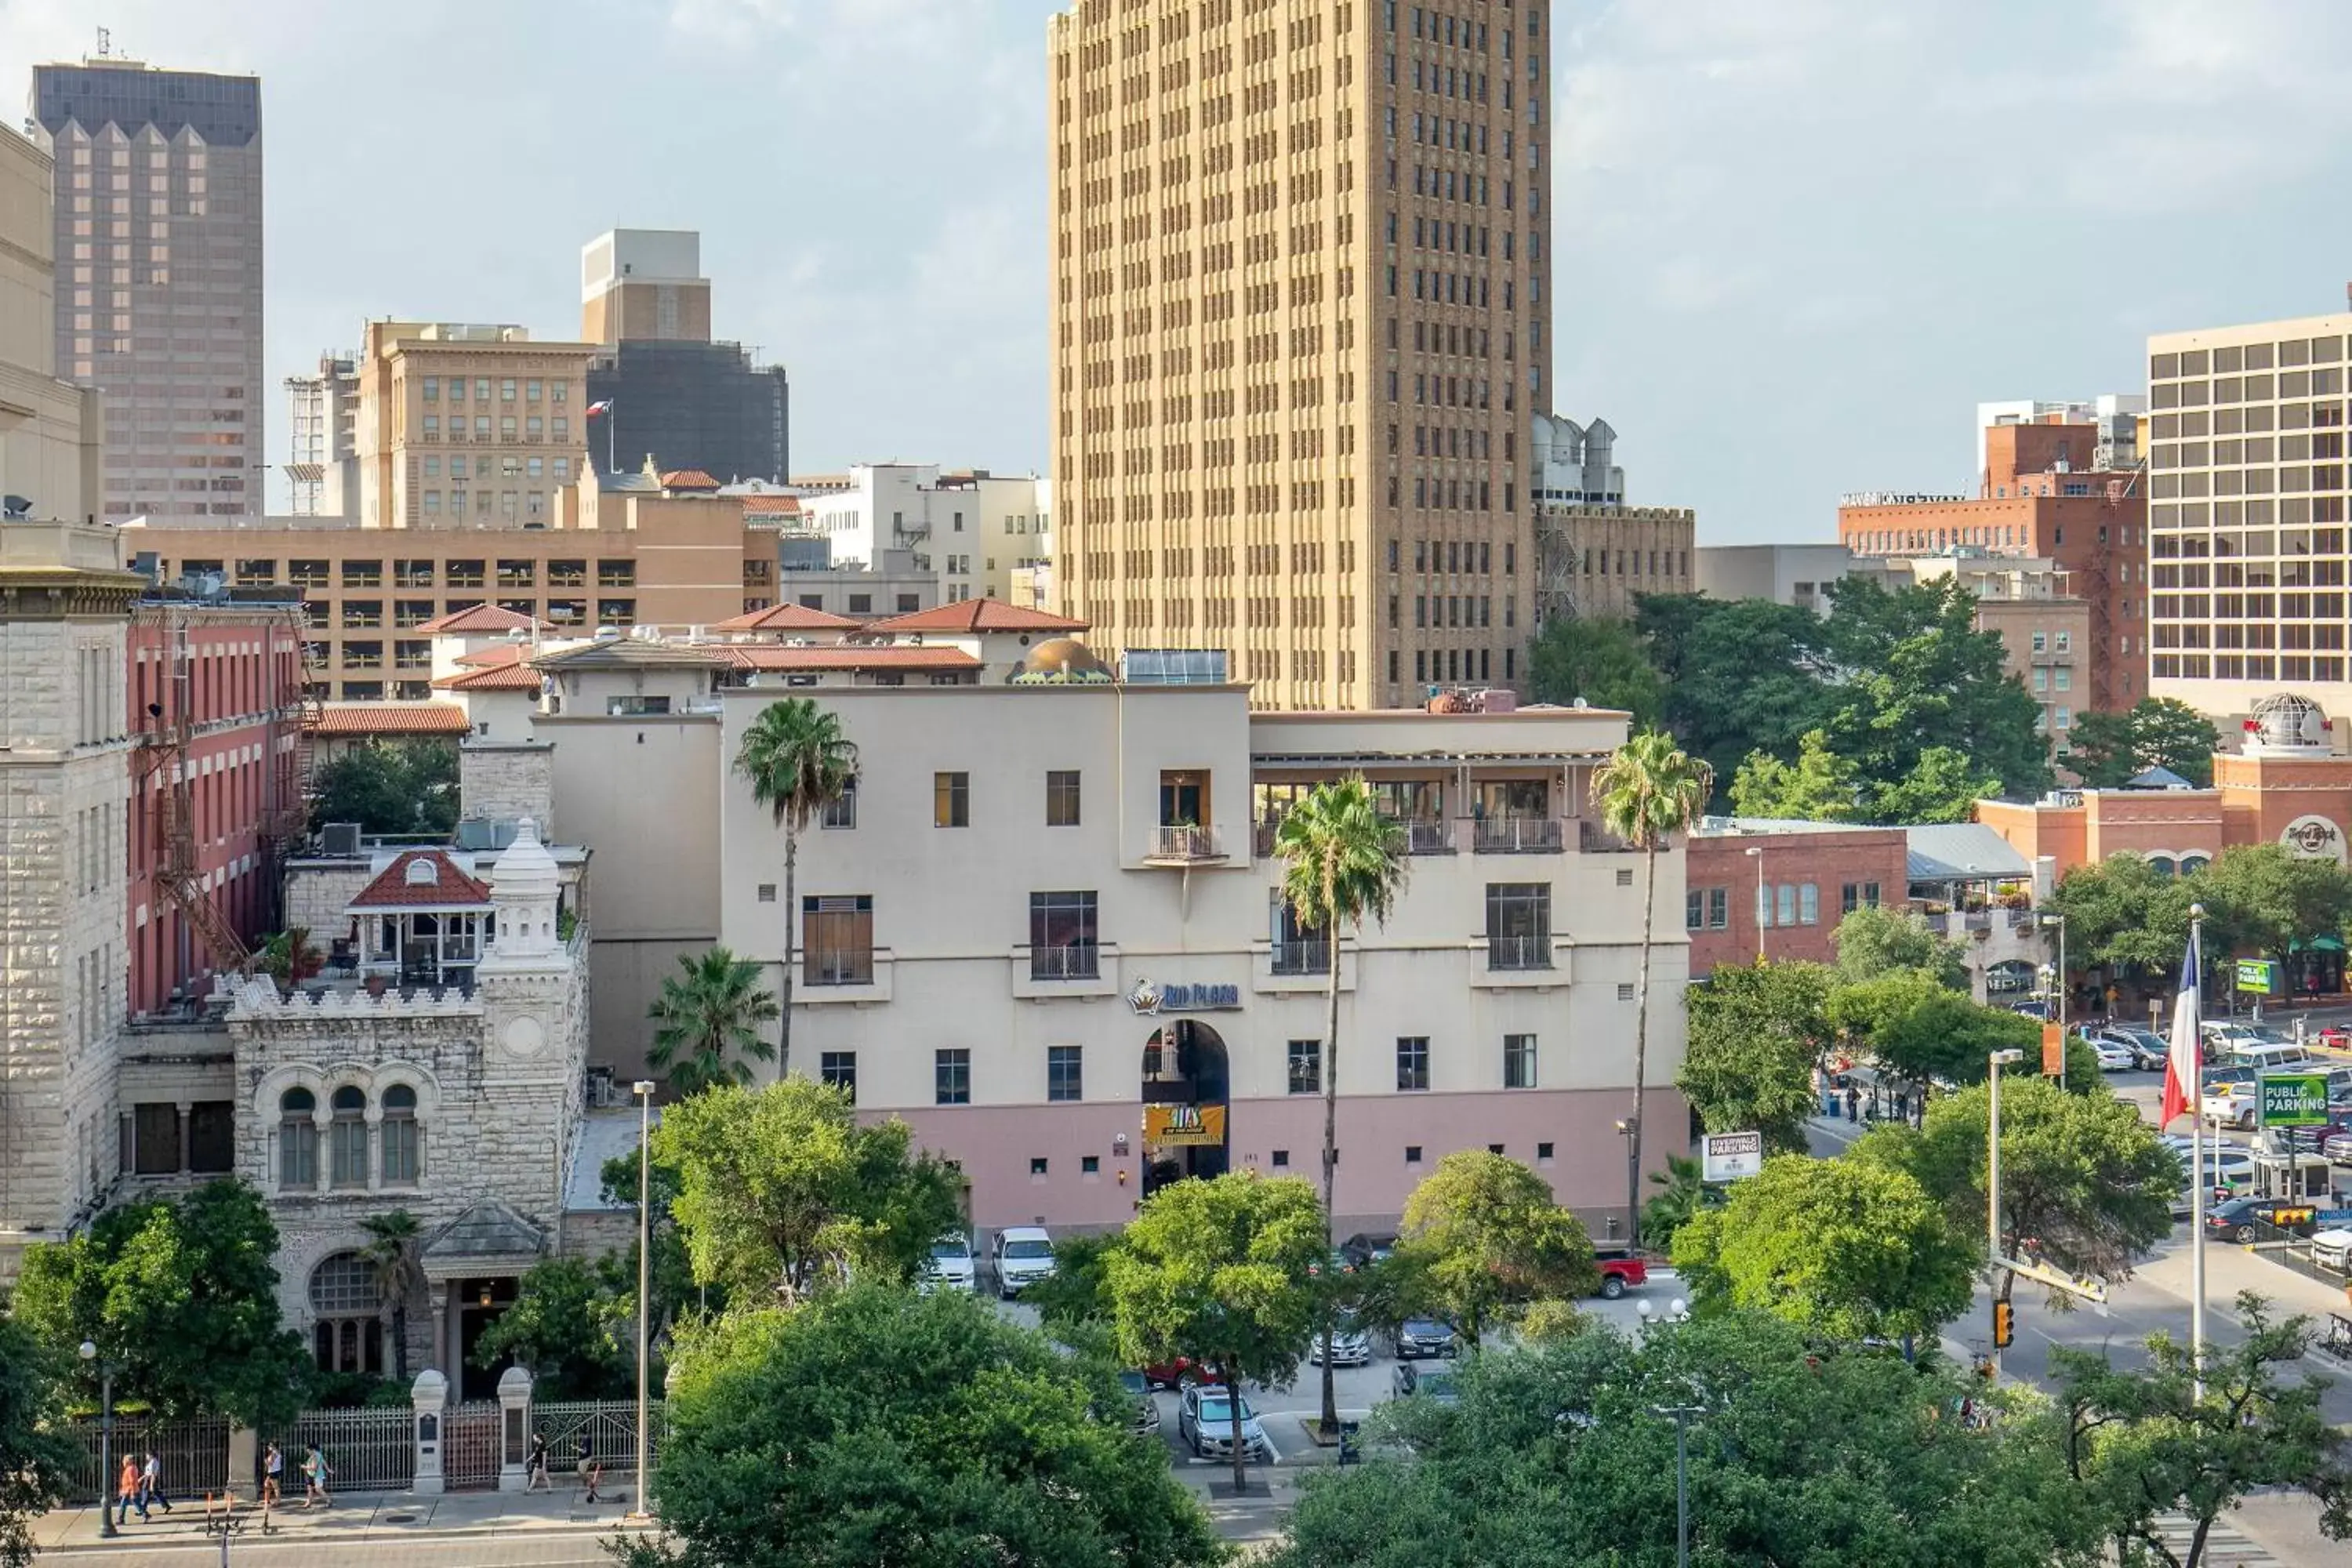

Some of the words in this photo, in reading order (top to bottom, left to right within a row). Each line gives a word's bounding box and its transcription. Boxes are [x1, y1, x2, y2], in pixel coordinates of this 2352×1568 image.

[2266, 1086, 2307, 1098] PUBLIC
[2266, 1098, 2325, 1111] PARKING
[1711, 1144, 1757, 1155] PARKING
